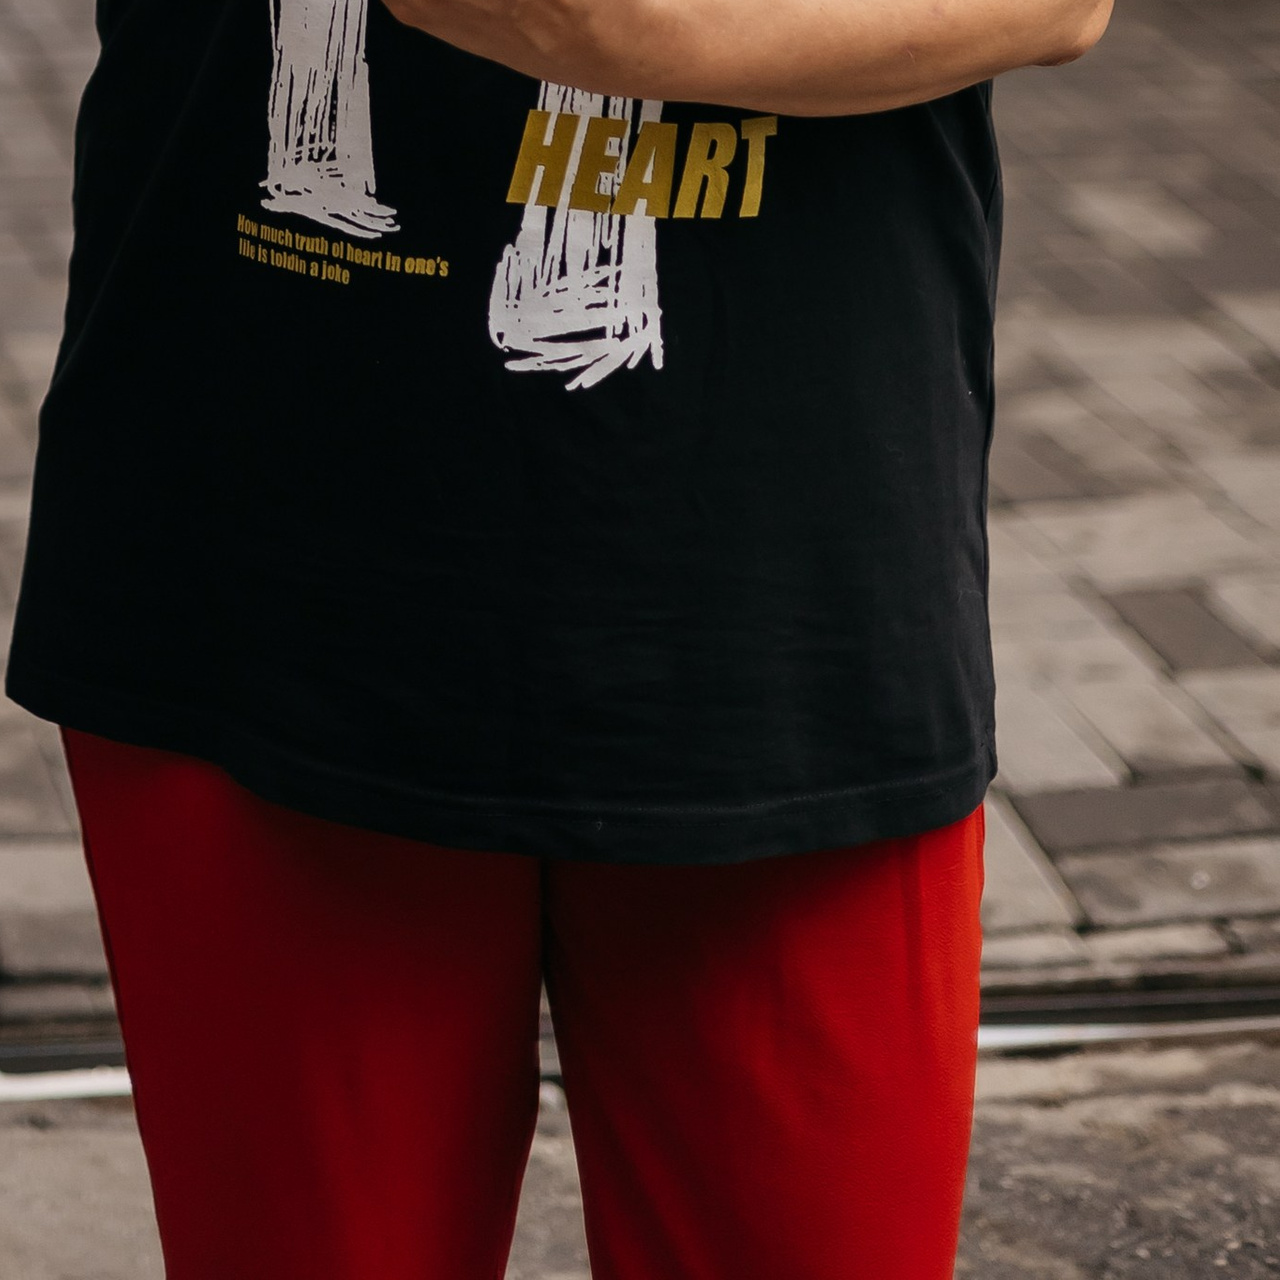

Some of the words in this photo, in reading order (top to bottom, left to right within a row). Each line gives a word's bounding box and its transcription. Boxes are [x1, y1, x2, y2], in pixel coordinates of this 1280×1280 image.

[506, 109, 778, 219] HEART
[237, 213, 258, 237] How
[260, 224, 293, 248] much
[294, 232, 329, 256] truth
[346, 242, 383, 269] heart
[385, 251, 401, 273] in
[404, 256, 449, 277] one's
[257, 243, 268, 264] is
[309, 261, 319, 277] a
[321, 260, 350, 285] joke
